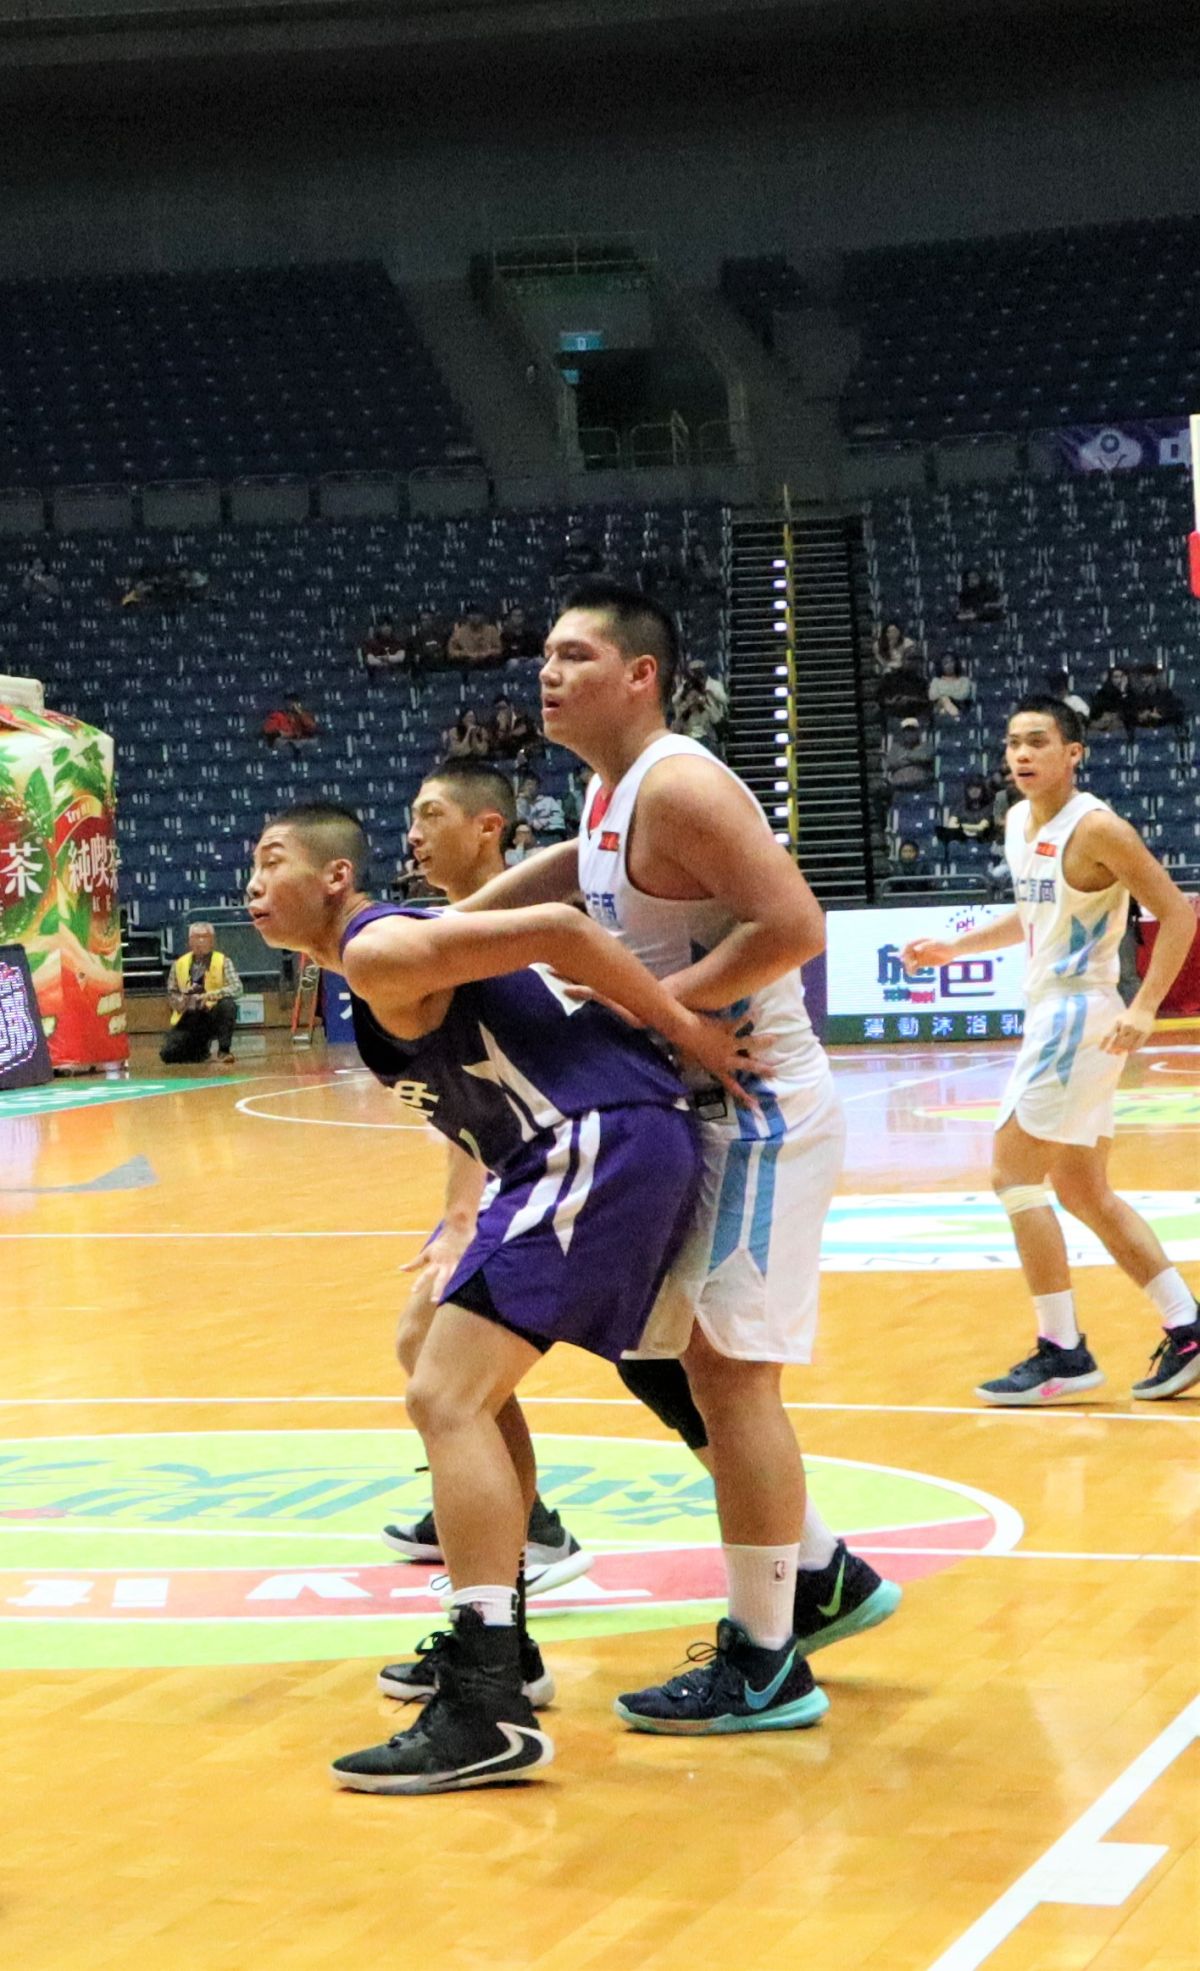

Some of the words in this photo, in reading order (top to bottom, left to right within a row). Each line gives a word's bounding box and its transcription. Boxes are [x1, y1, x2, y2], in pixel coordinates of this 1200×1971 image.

[0, 841, 43, 898] 茶
[67, 832, 122, 894] 純喫茶
[863, 1013, 1024, 1039] 運動沐浴乳
